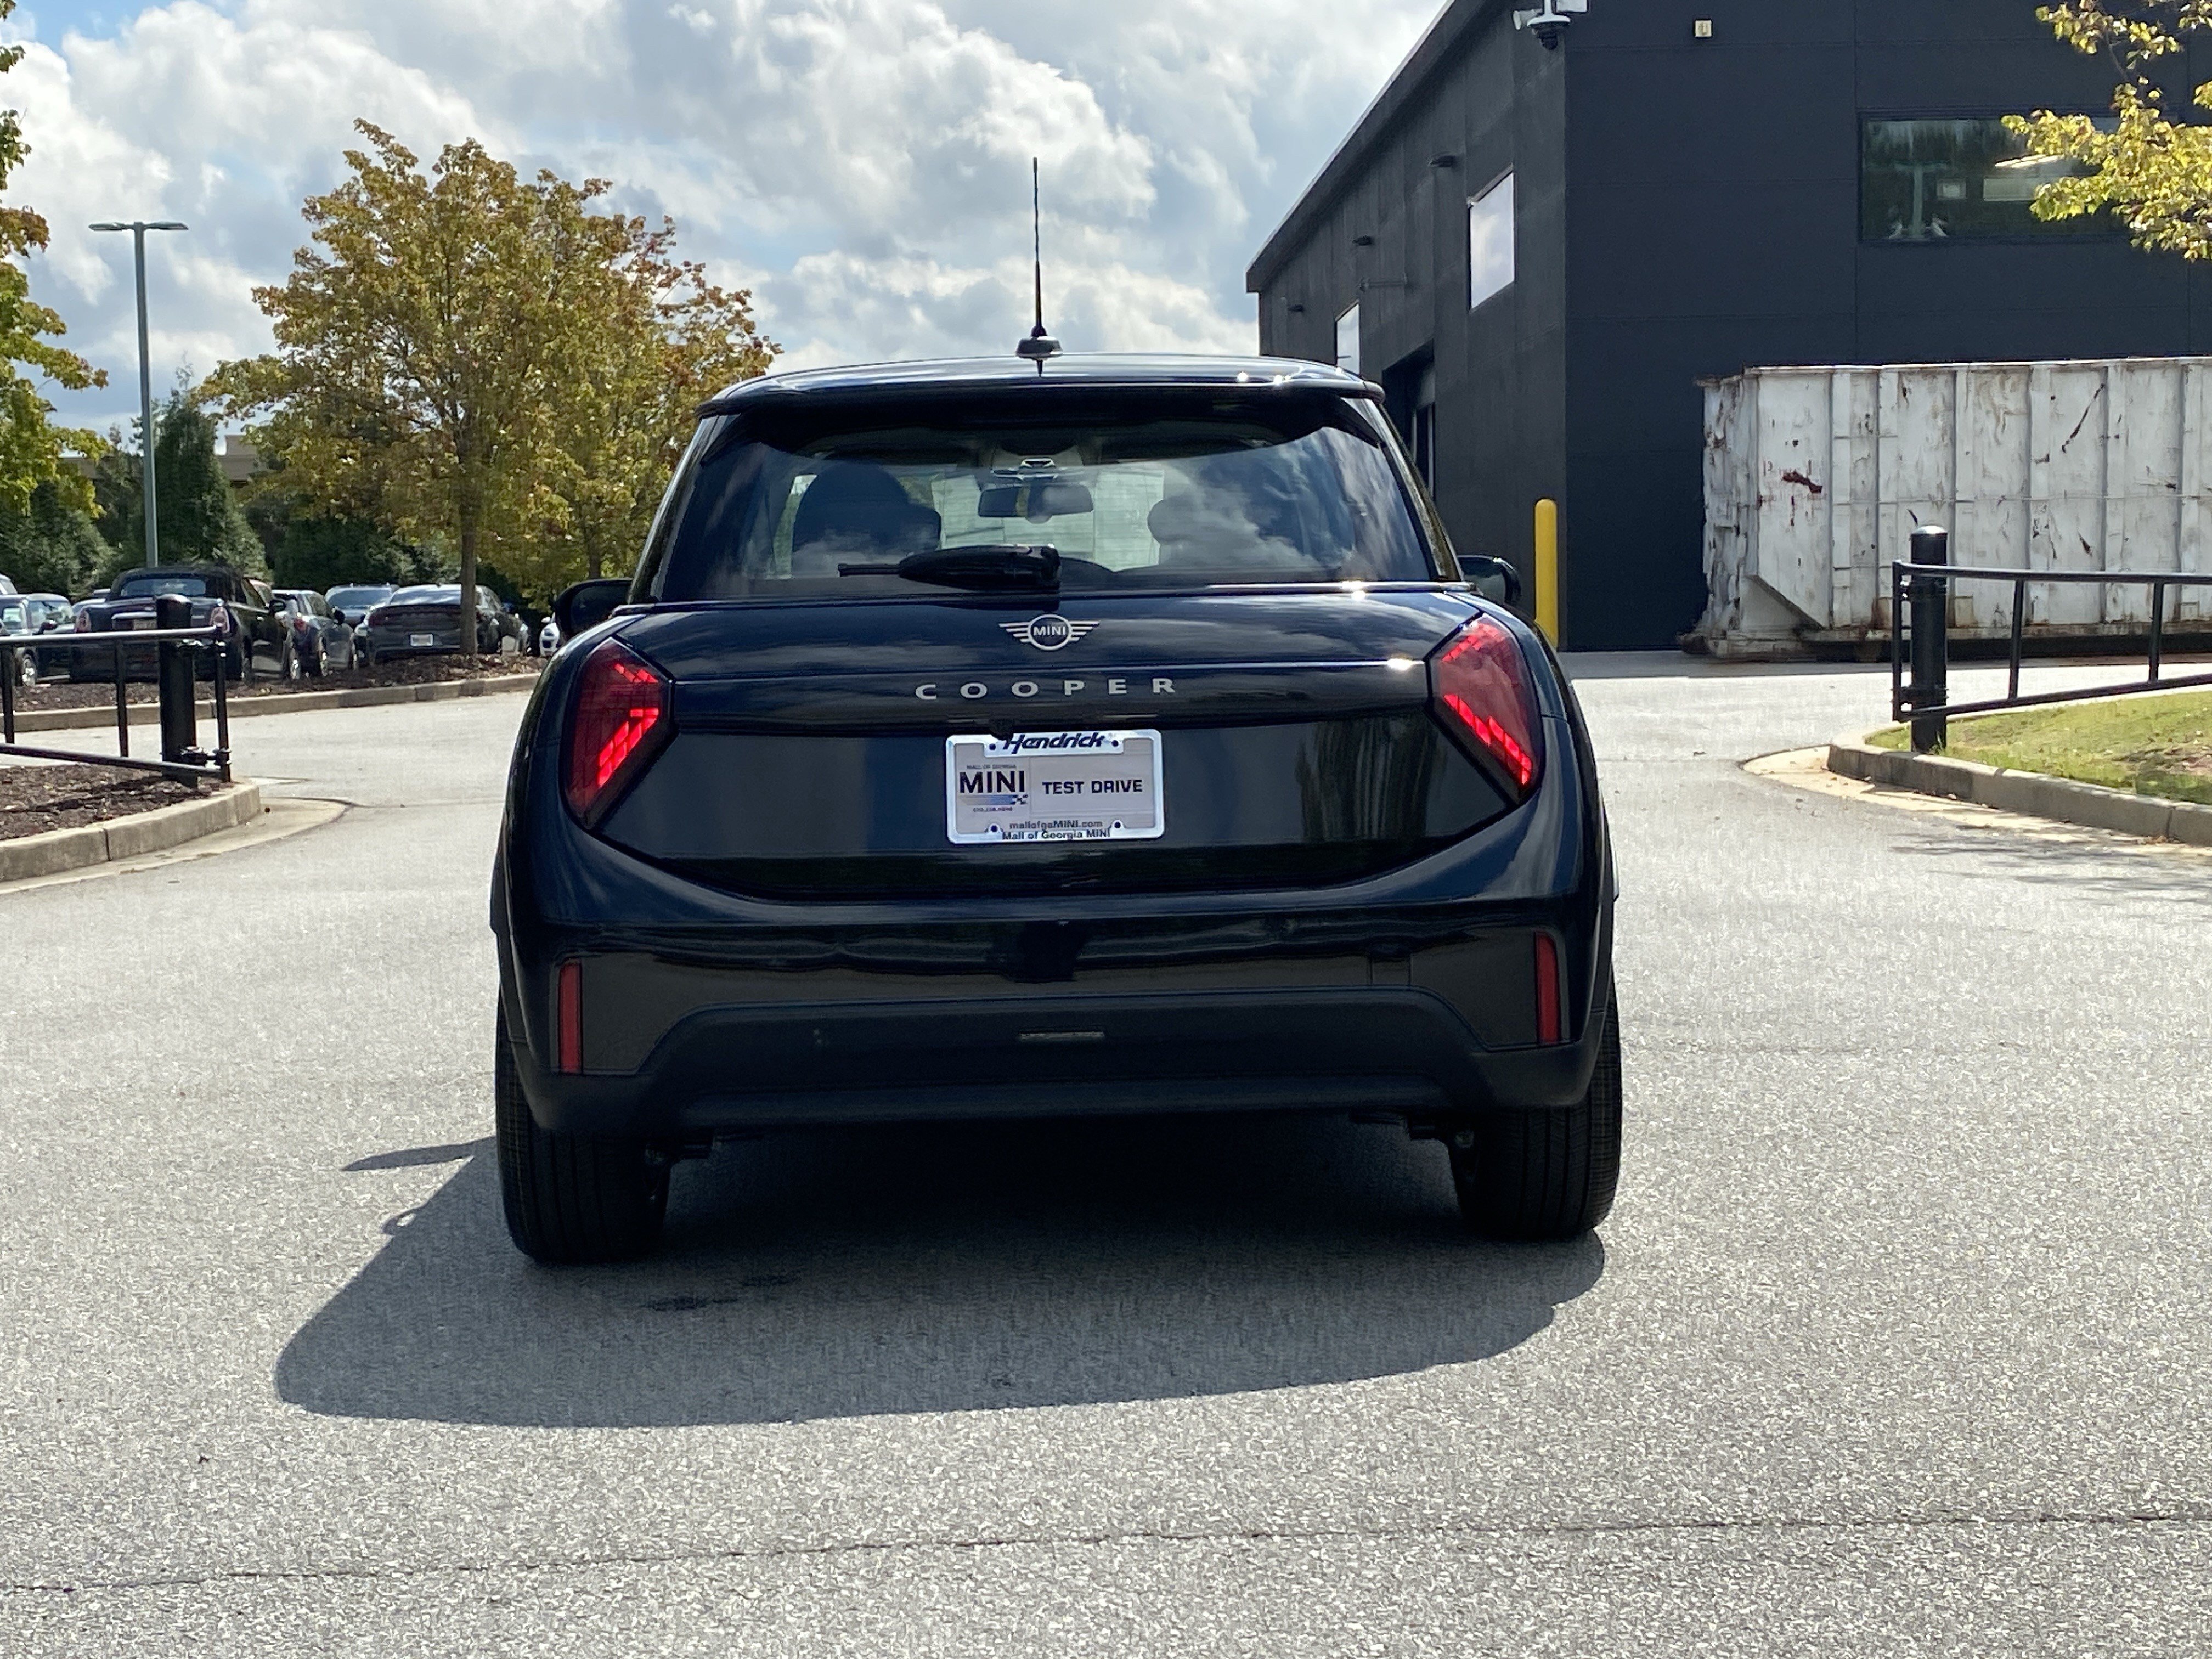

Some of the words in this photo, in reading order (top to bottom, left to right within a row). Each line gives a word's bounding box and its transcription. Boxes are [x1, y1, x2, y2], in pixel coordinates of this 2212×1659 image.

[1033, 626, 1066, 636] MINI
[916, 678, 1175, 699] COOPER
[1003, 732, 1105, 754] Hendrick
[960, 770, 1025, 793] MINI
[1042, 781, 1084, 794] TEST
[1091, 780, 1142, 793] DRIVE
[1009, 820, 1103, 830] mallofgaMINI.com
[1002, 831, 1024, 840] Mall
[1028, 831, 1038, 839] of
[1041, 829, 1083, 840] Georgia
[1086, 828, 1110, 838] MINI
